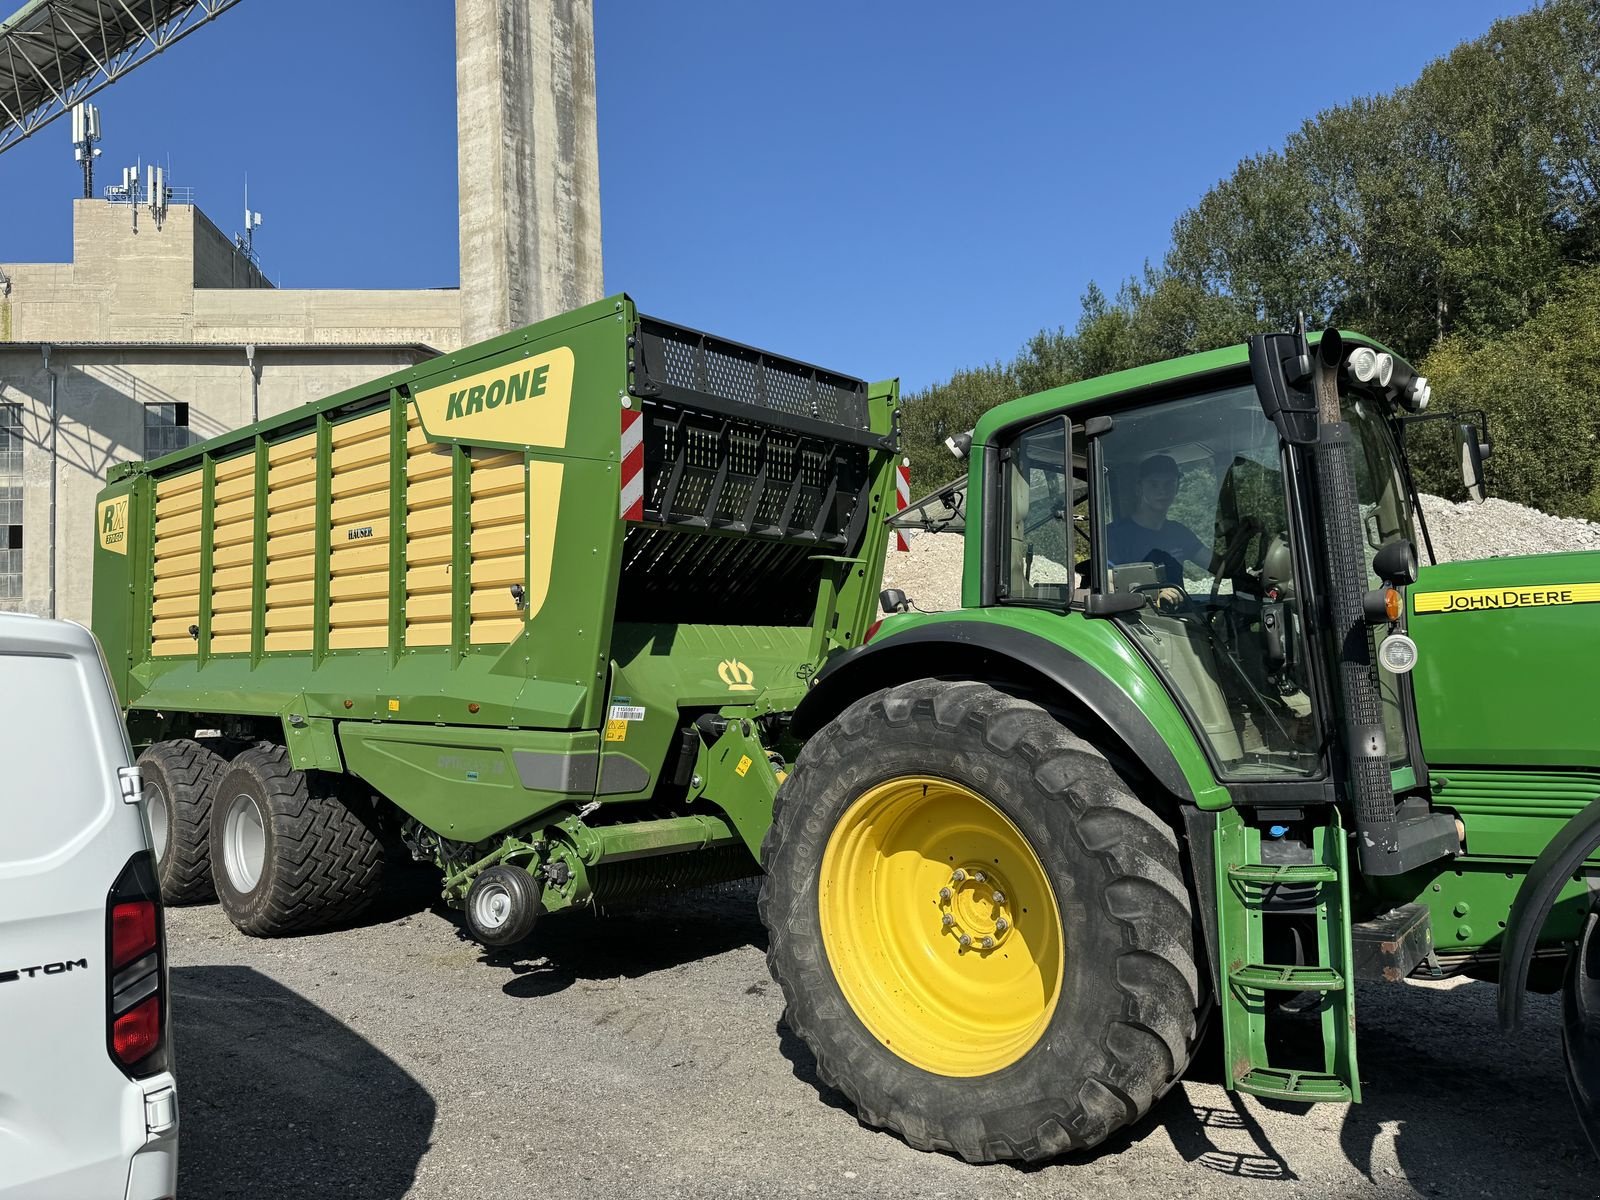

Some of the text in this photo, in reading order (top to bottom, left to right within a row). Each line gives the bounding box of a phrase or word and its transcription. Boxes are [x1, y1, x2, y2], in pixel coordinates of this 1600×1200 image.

[446, 364, 550, 421] KRONE
[103, 501, 127, 533] RX
[348, 527, 373, 539] HAUSER
[1444, 591, 1573, 609] JOHN DEERE
